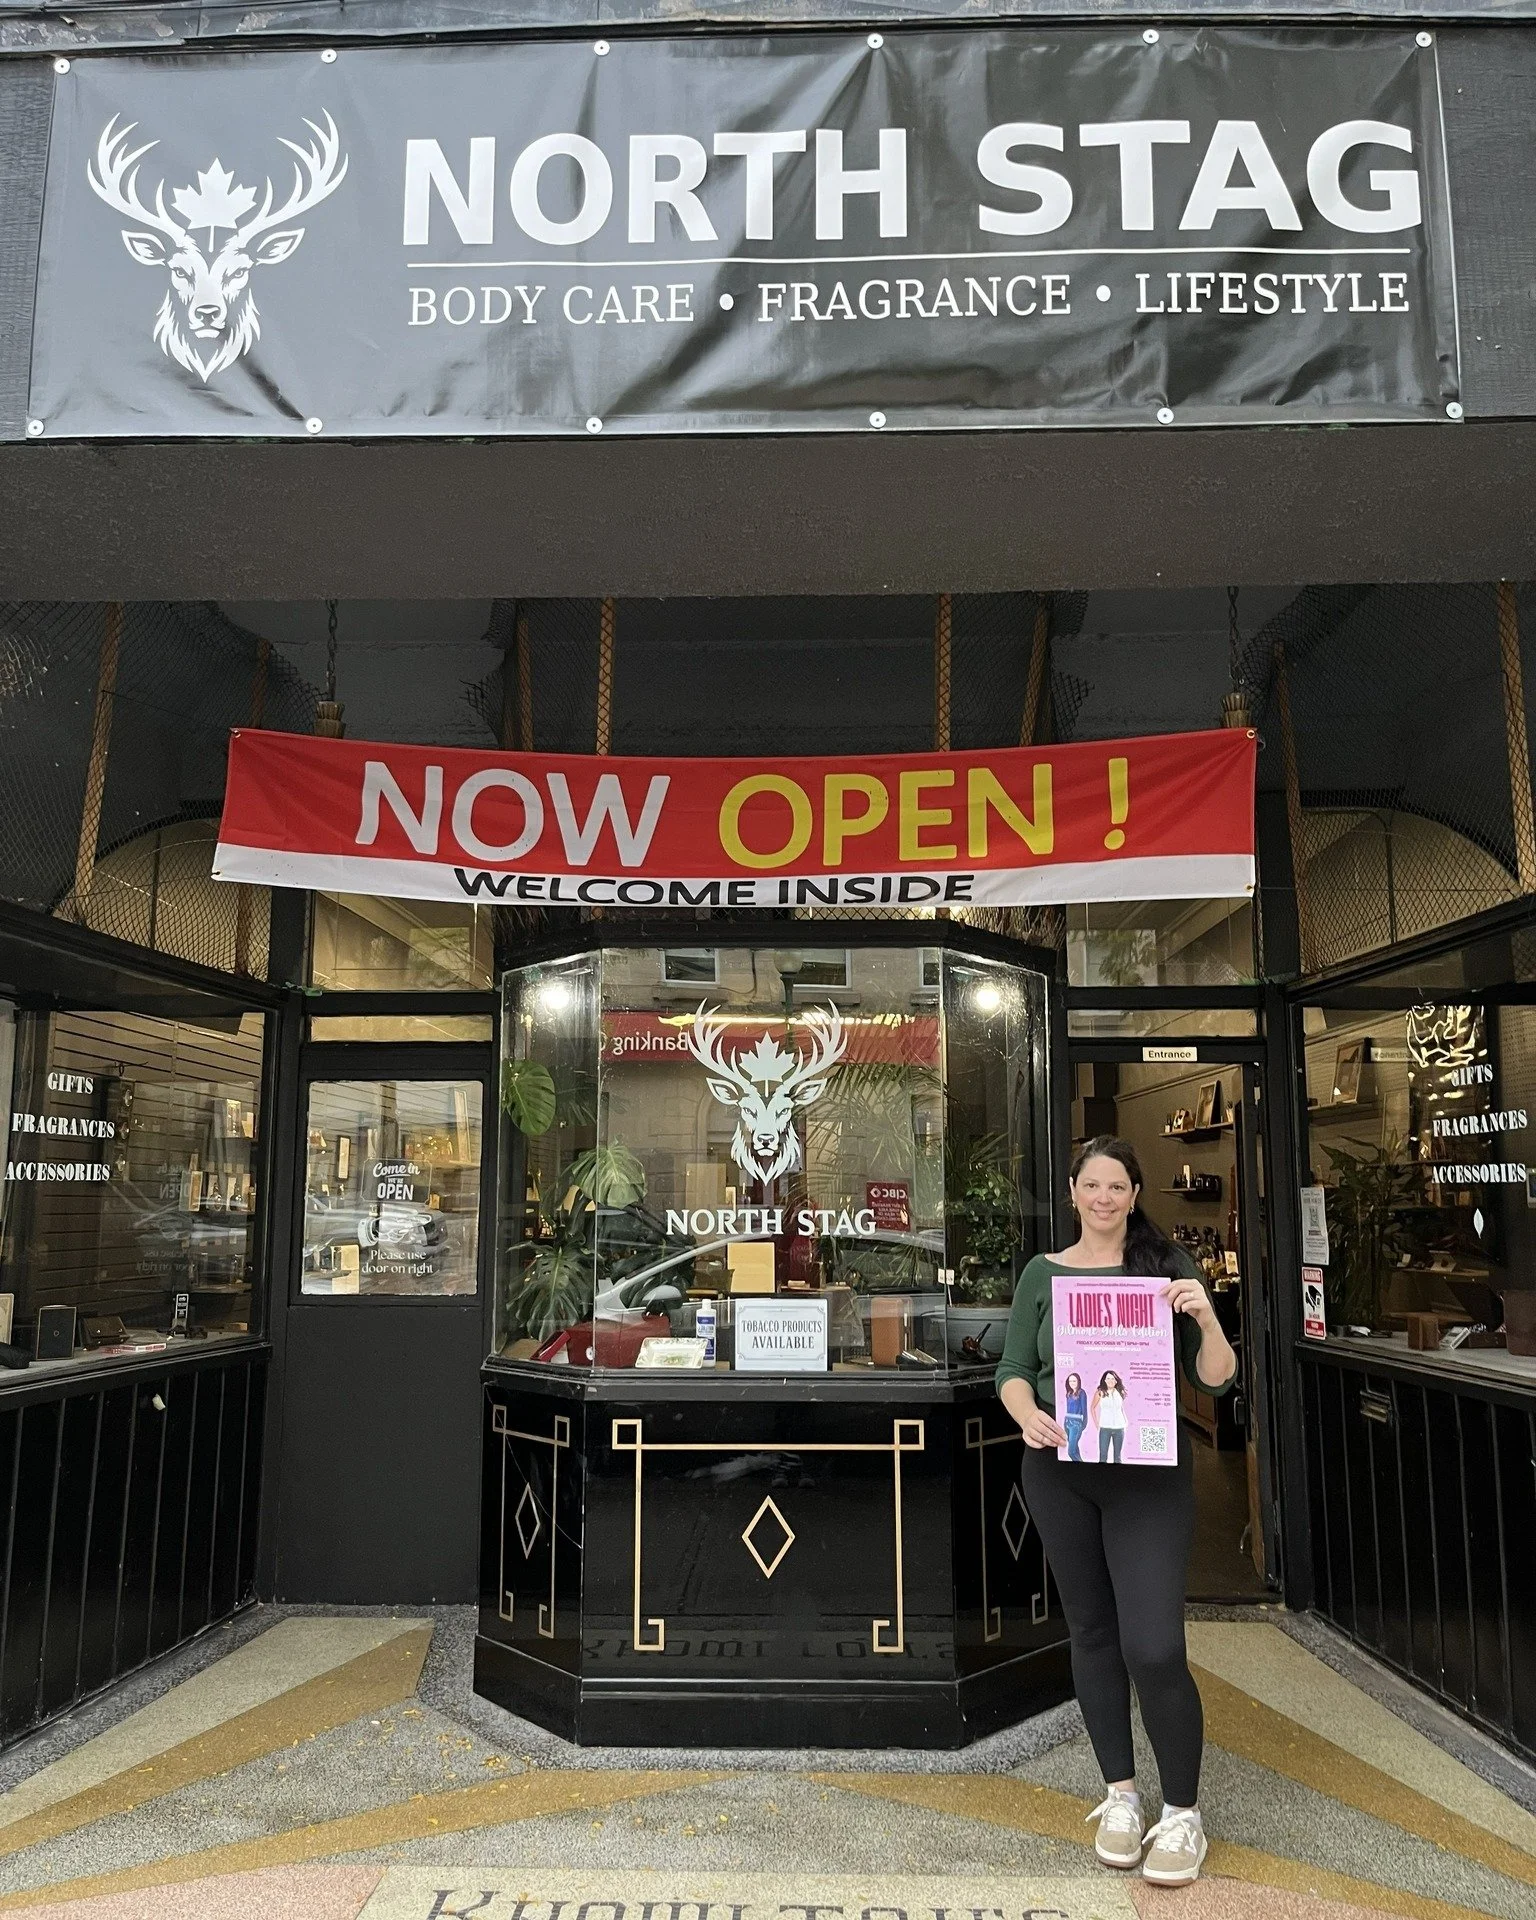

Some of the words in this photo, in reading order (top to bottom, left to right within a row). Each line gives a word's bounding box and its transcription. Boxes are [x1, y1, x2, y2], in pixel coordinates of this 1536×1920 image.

[402, 128, 907, 246] NORTH
[976, 119, 1422, 237] STAG
[408, 285, 543, 326] BODY
[563, 284, 695, 325] CARE
[757, 275, 1072, 323] FRAGRANCE
[1136, 272, 1410, 315] LIFESTYLE
[355, 761, 670, 867] NOW
[718, 763, 1053, 868] OPEN
[453, 868, 757, 907] WELCOME
[777, 874, 974, 905] INSIDE
[1148, 1050, 1191, 1059] Entrance
[47, 1072, 94, 1095] GIFTS
[1450, 1063, 1493, 1087] GIFTS
[11, 1113, 115, 1139] FRAGRANCES
[1433, 1109, 1527, 1138] FRAGRANCES
[4, 1161, 111, 1182] ACCESSORIES
[373, 1162, 406, 1178] Come
[407, 1162, 420, 1175] in
[1431, 1163, 1526, 1184] ACCESSORIES
[377, 1183, 414, 1200] OPEN
[666, 1208, 783, 1236] NORTH
[798, 1208, 877, 1236] STAG
[370, 1250, 406, 1260] Please
[407, 1251, 426, 1260] use
[361, 1263, 389, 1274] door
[391, 1264, 406, 1274] on
[408, 1262, 434, 1277] right
[1068, 1292, 1113, 1328] LADIES
[1116, 1293, 1155, 1328] NIGHT
[742, 1320, 780, 1333] TOBACCO
[782, 1320, 822, 1333] PRODUCTS
[752, 1336, 815, 1349] AVAILABLE
